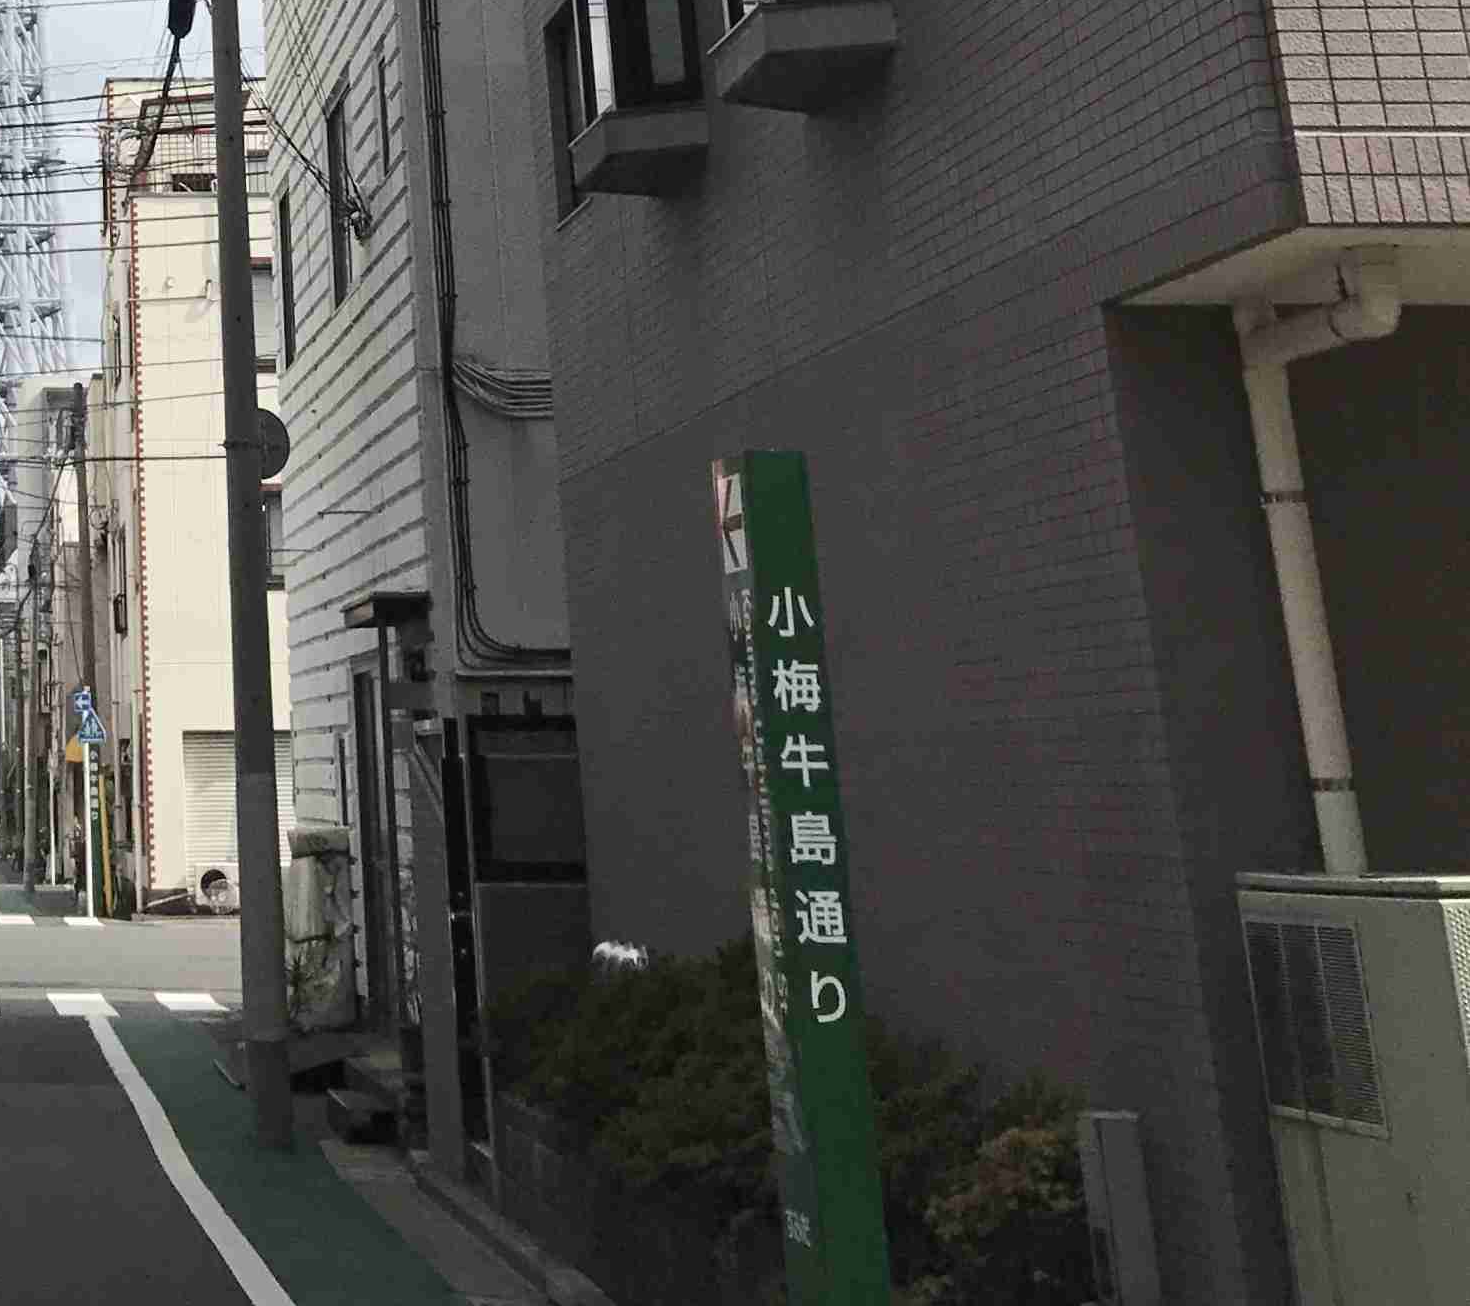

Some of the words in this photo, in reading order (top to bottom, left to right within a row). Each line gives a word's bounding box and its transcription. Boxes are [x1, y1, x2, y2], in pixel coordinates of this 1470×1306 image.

[767, 586, 847, 1023] 小梅牛島通り
